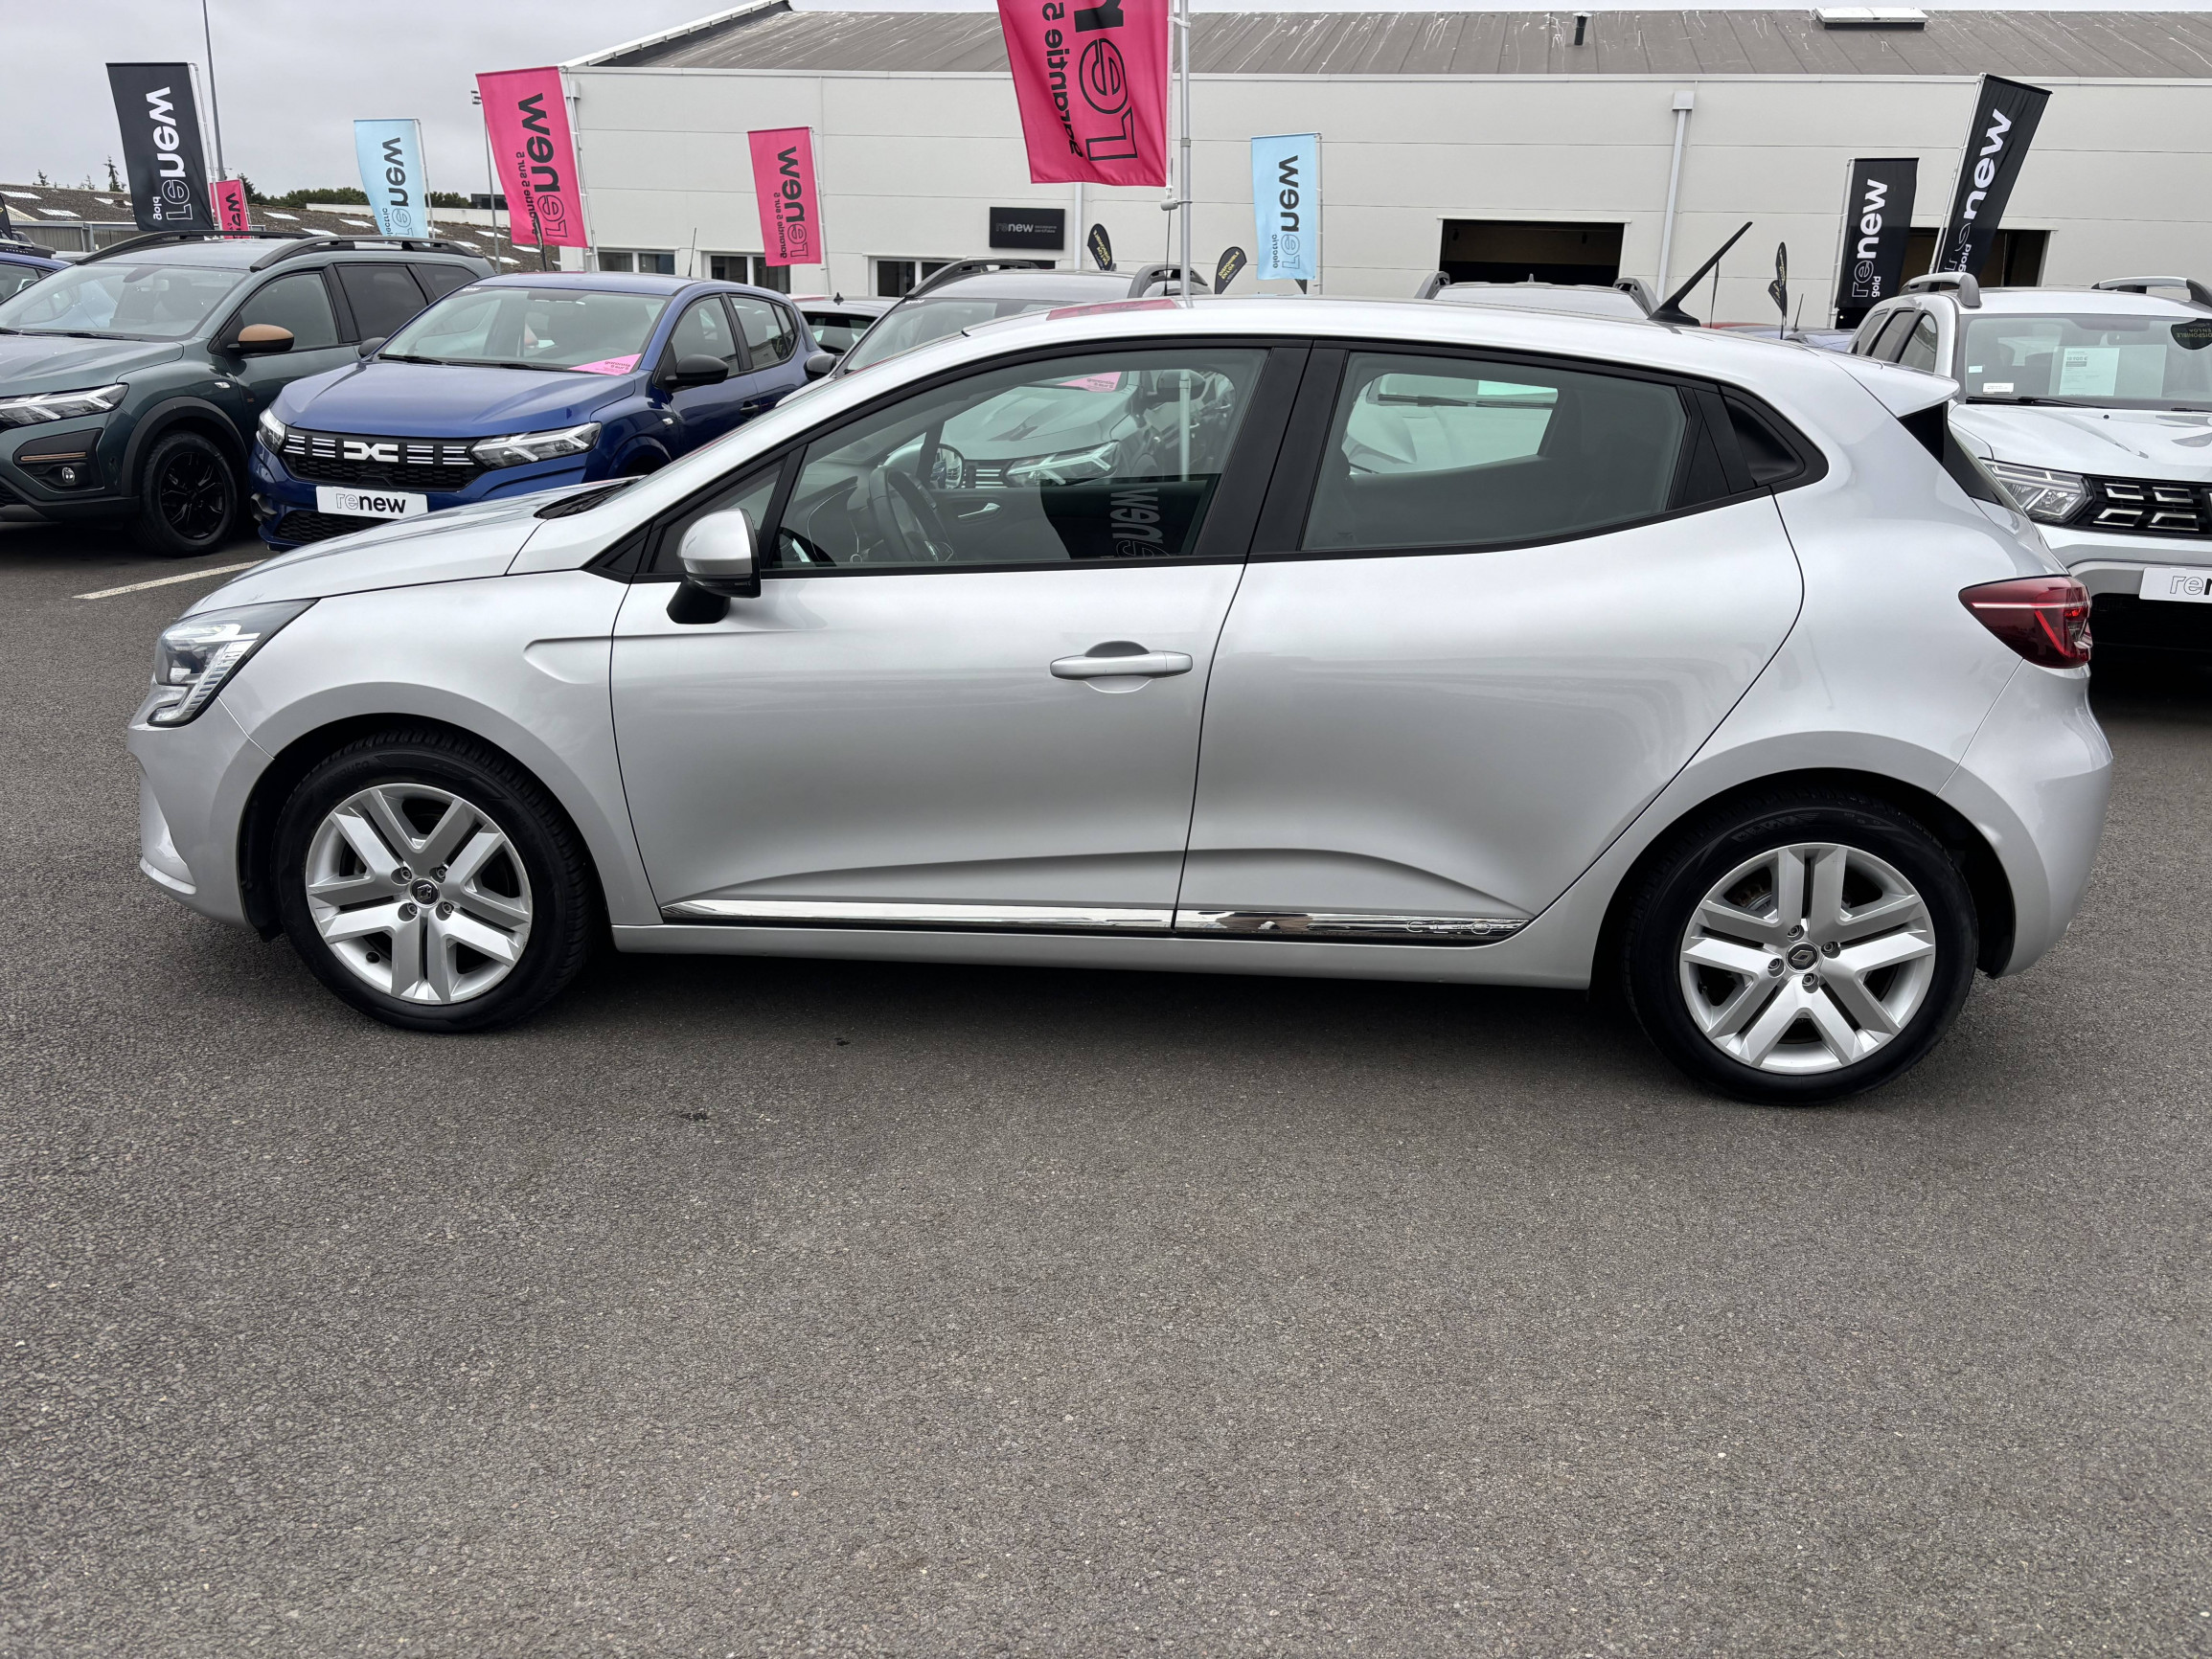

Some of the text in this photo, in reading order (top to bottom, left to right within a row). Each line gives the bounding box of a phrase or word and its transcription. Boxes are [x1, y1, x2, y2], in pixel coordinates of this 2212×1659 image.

[1852, 179, 1888, 297] renew
[1958, 244, 1972, 272] gold
[1872, 276, 1881, 298] gold
[336, 492, 406, 513] renew
